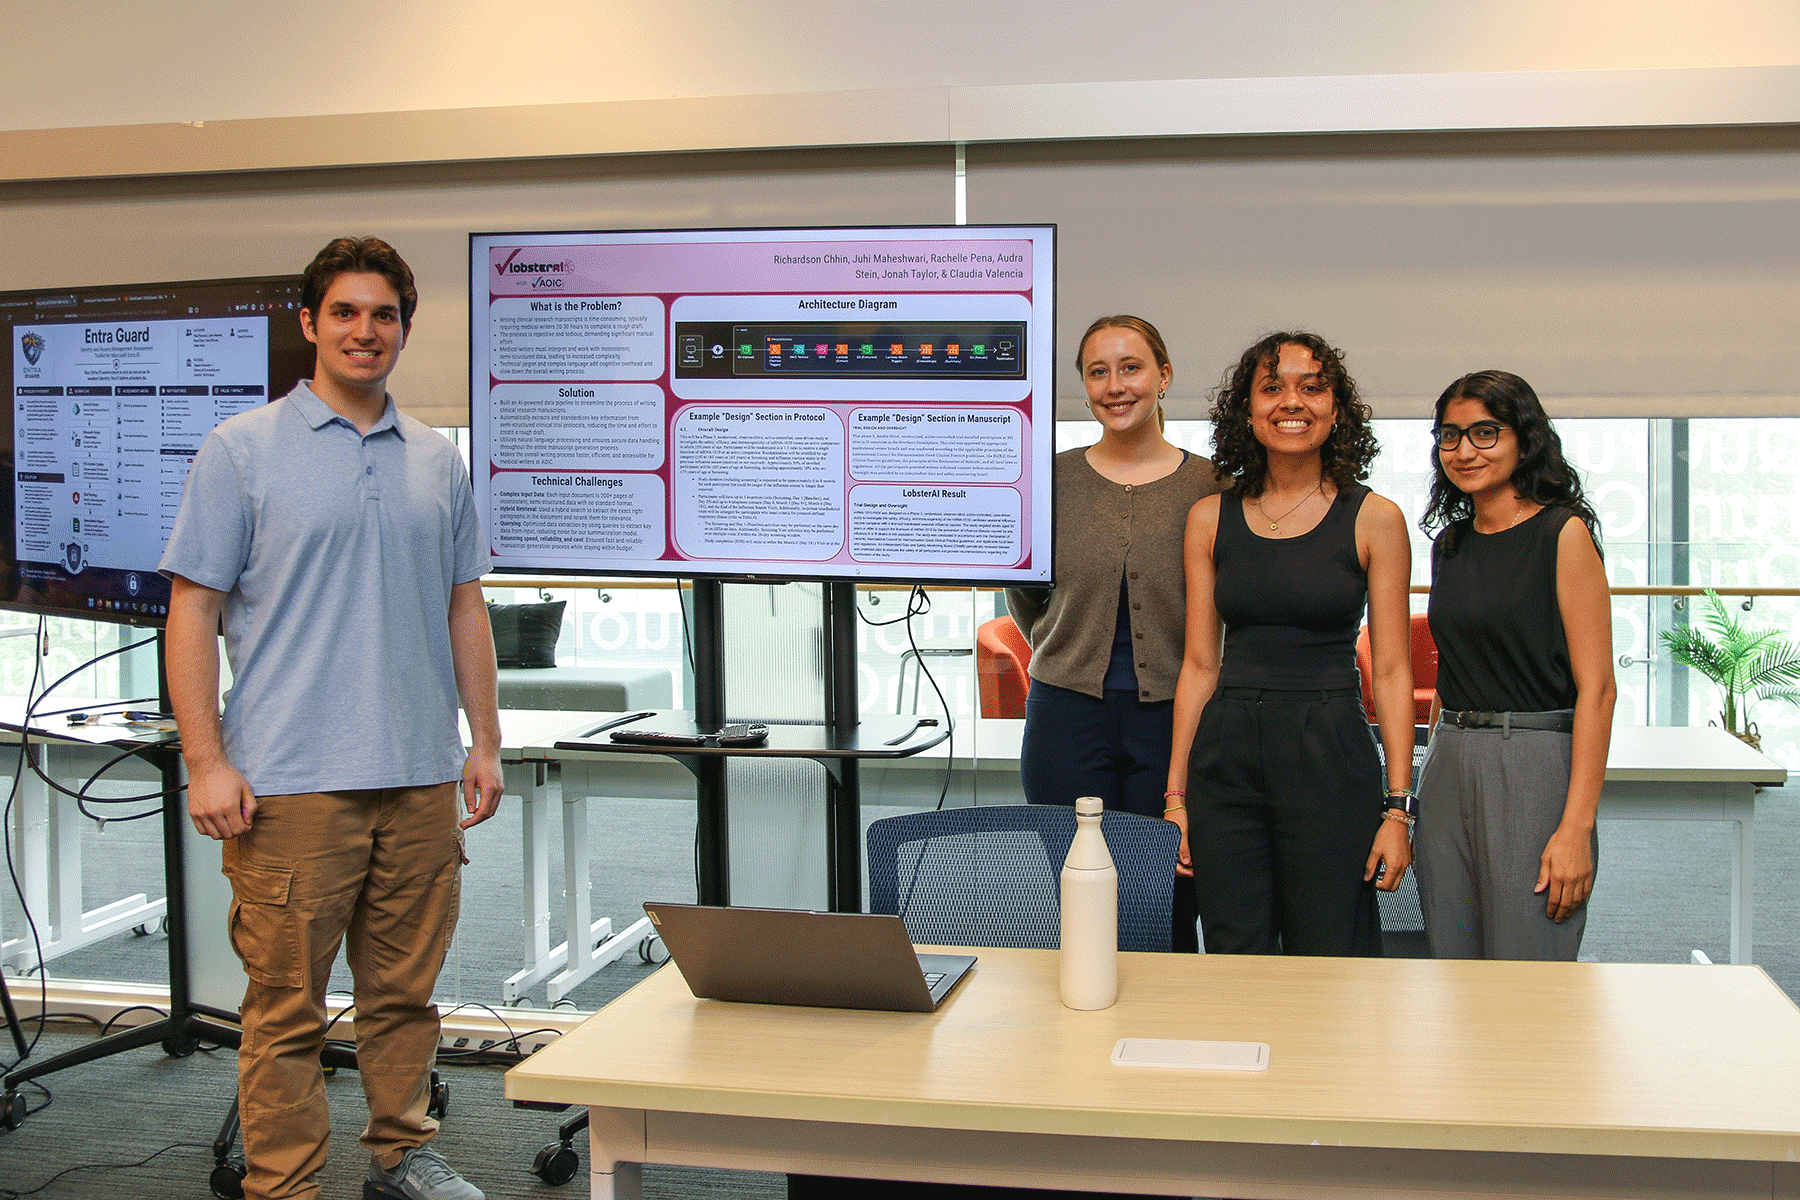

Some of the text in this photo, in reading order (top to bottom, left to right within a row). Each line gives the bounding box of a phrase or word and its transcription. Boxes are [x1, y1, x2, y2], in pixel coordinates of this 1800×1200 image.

[774, 253, 1023, 266] Richardson Chhin, Juhi Maheshwari, Rachelle Pena, Audra
[856, 269, 1023, 281] Stein, Jonah Taylor, & Claudia Valencia
[530, 302, 622, 312] What is the Problem?
[798, 300, 897, 311] Architecture Diagram
[85, 326, 149, 343] Entra Guard
[559, 388, 594, 398] Solution
[690, 412, 720, 423] Example
[756, 413, 783, 421] Section
[786, 413, 792, 421] in
[795, 413, 825, 422] Protocol
[859, 413, 890, 424] Example
[928, 414, 956, 423] Section
[959, 414, 966, 423] in
[968, 414, 1011, 425] Manuscript
[532, 476, 623, 489] Technical Challenges
[903, 489, 966, 498] LobsterAI Result
